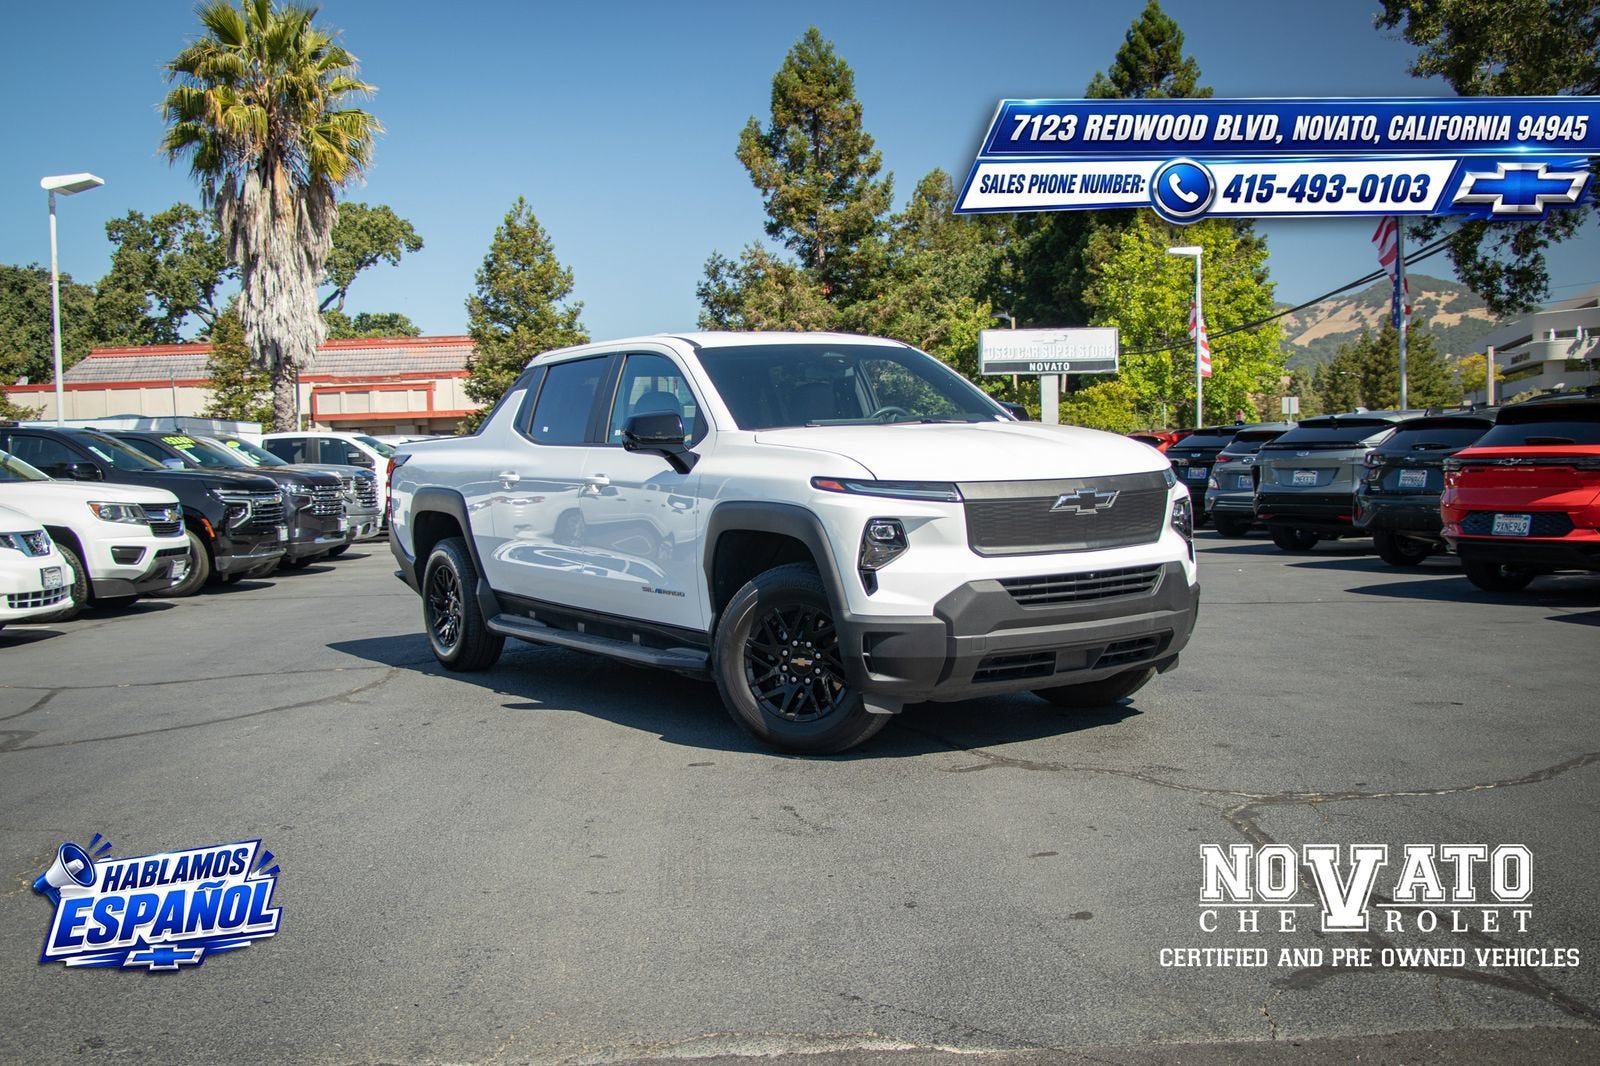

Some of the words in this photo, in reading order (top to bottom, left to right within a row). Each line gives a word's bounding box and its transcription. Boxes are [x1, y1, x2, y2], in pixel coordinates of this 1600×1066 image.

[987, 346, 1015, 359] USED
[1017, 345, 1039, 358] CAR
[1041, 344, 1077, 358] SUPER
[1079, 344, 1113, 357] STORE
[1029, 362, 1070, 371] NOVATO
